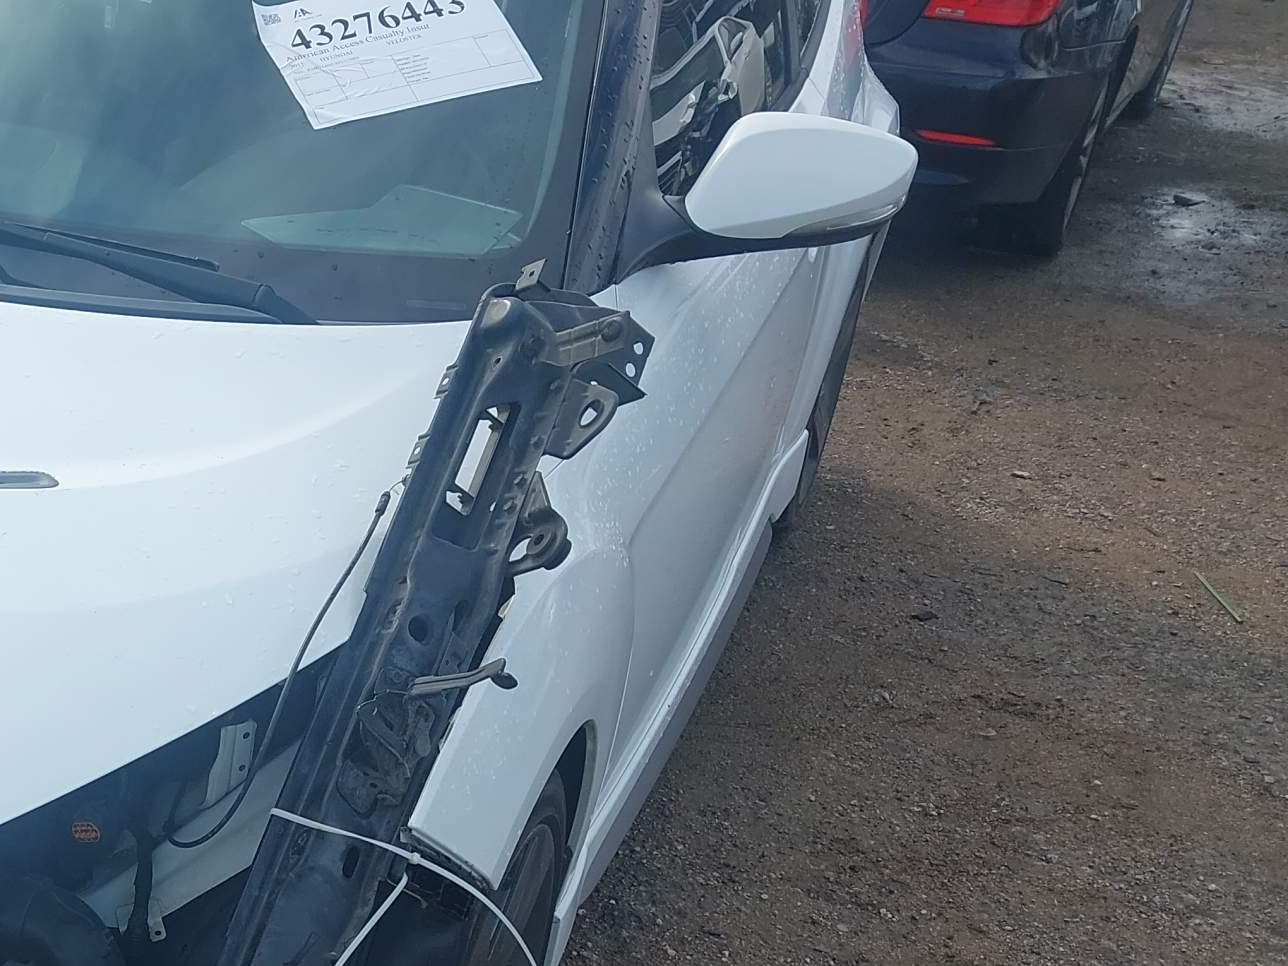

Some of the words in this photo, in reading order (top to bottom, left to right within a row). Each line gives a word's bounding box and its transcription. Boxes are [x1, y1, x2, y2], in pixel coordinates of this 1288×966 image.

[291, 0, 466, 50] 43276443
[332, 38, 365, 52] Access
[365, 29, 405, 44] Casualty
